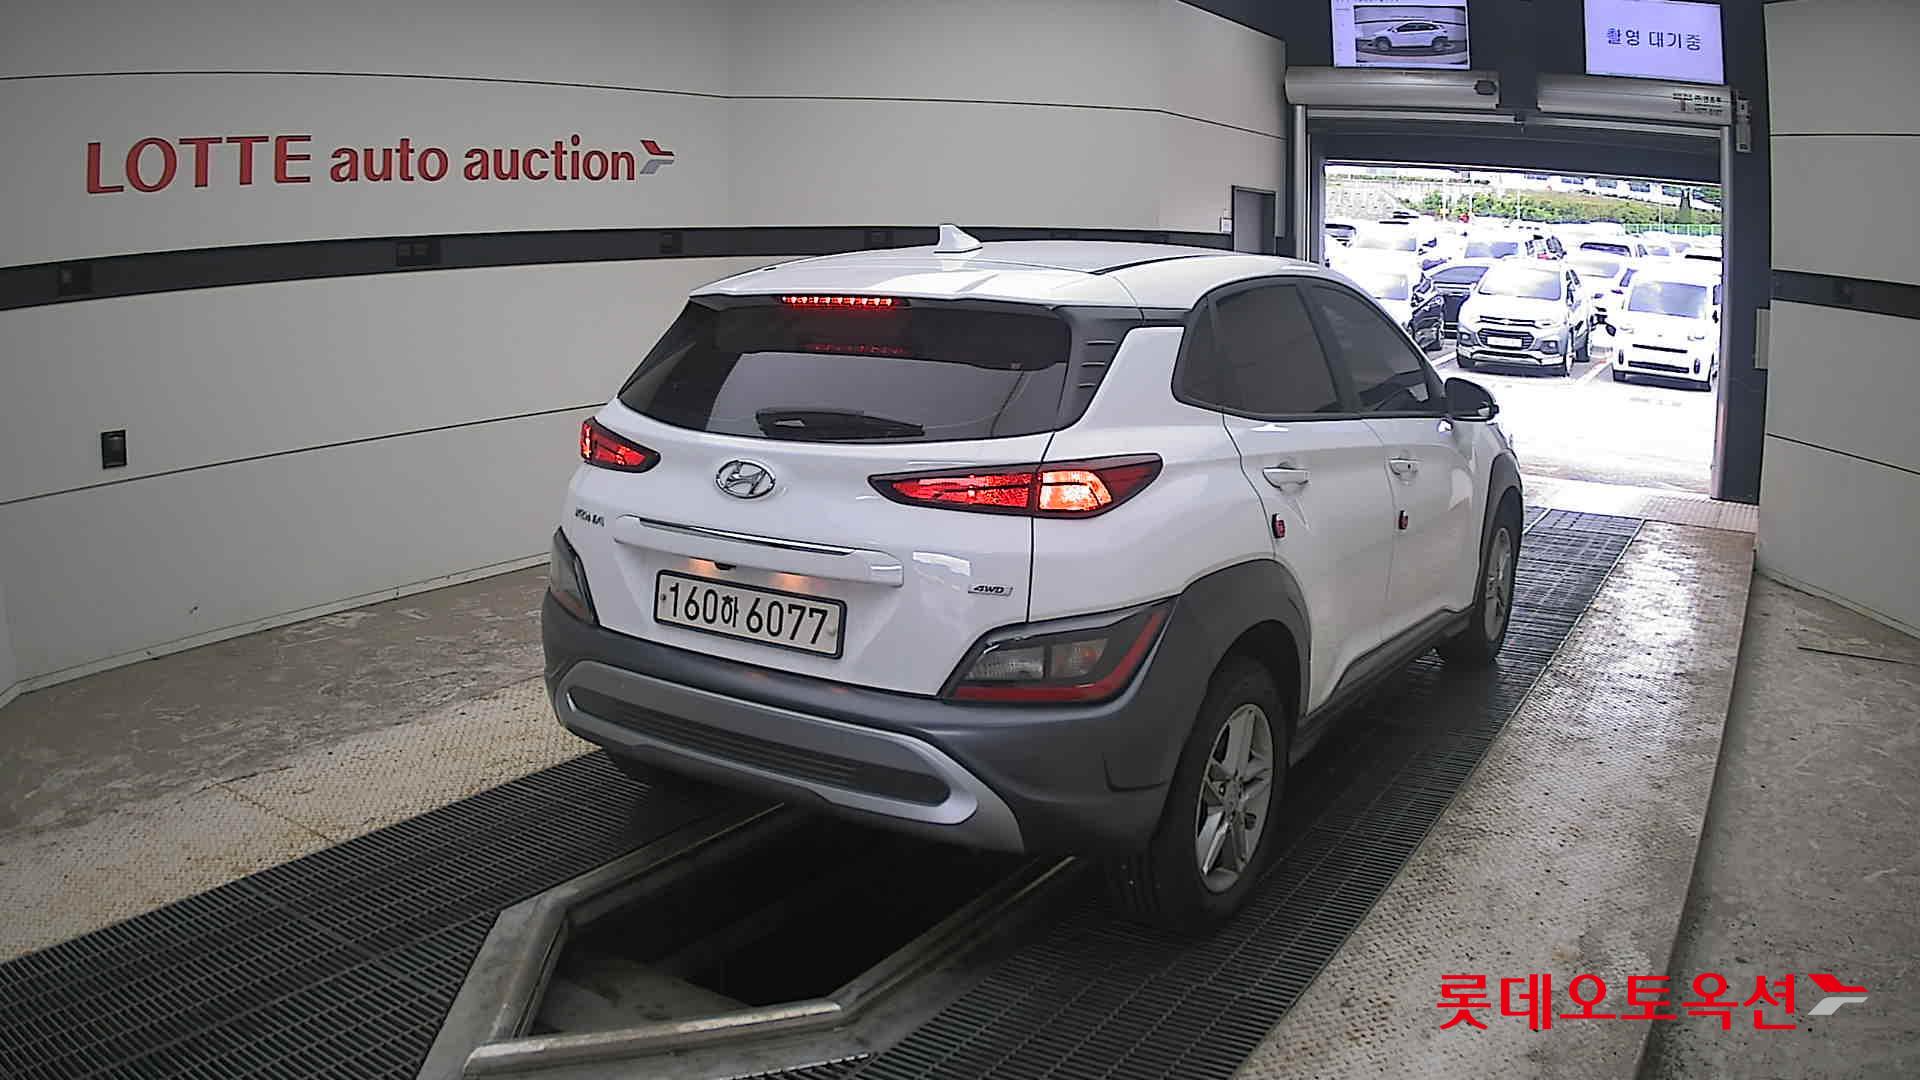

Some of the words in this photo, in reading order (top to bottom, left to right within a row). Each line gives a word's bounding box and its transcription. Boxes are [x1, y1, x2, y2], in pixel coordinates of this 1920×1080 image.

[86, 134, 312, 194] LOTTE
[329, 137, 449, 182] auto
[463, 134, 636, 182] auction
[973, 584, 1005, 595] 4WD
[746, 597, 828, 645] 6077
